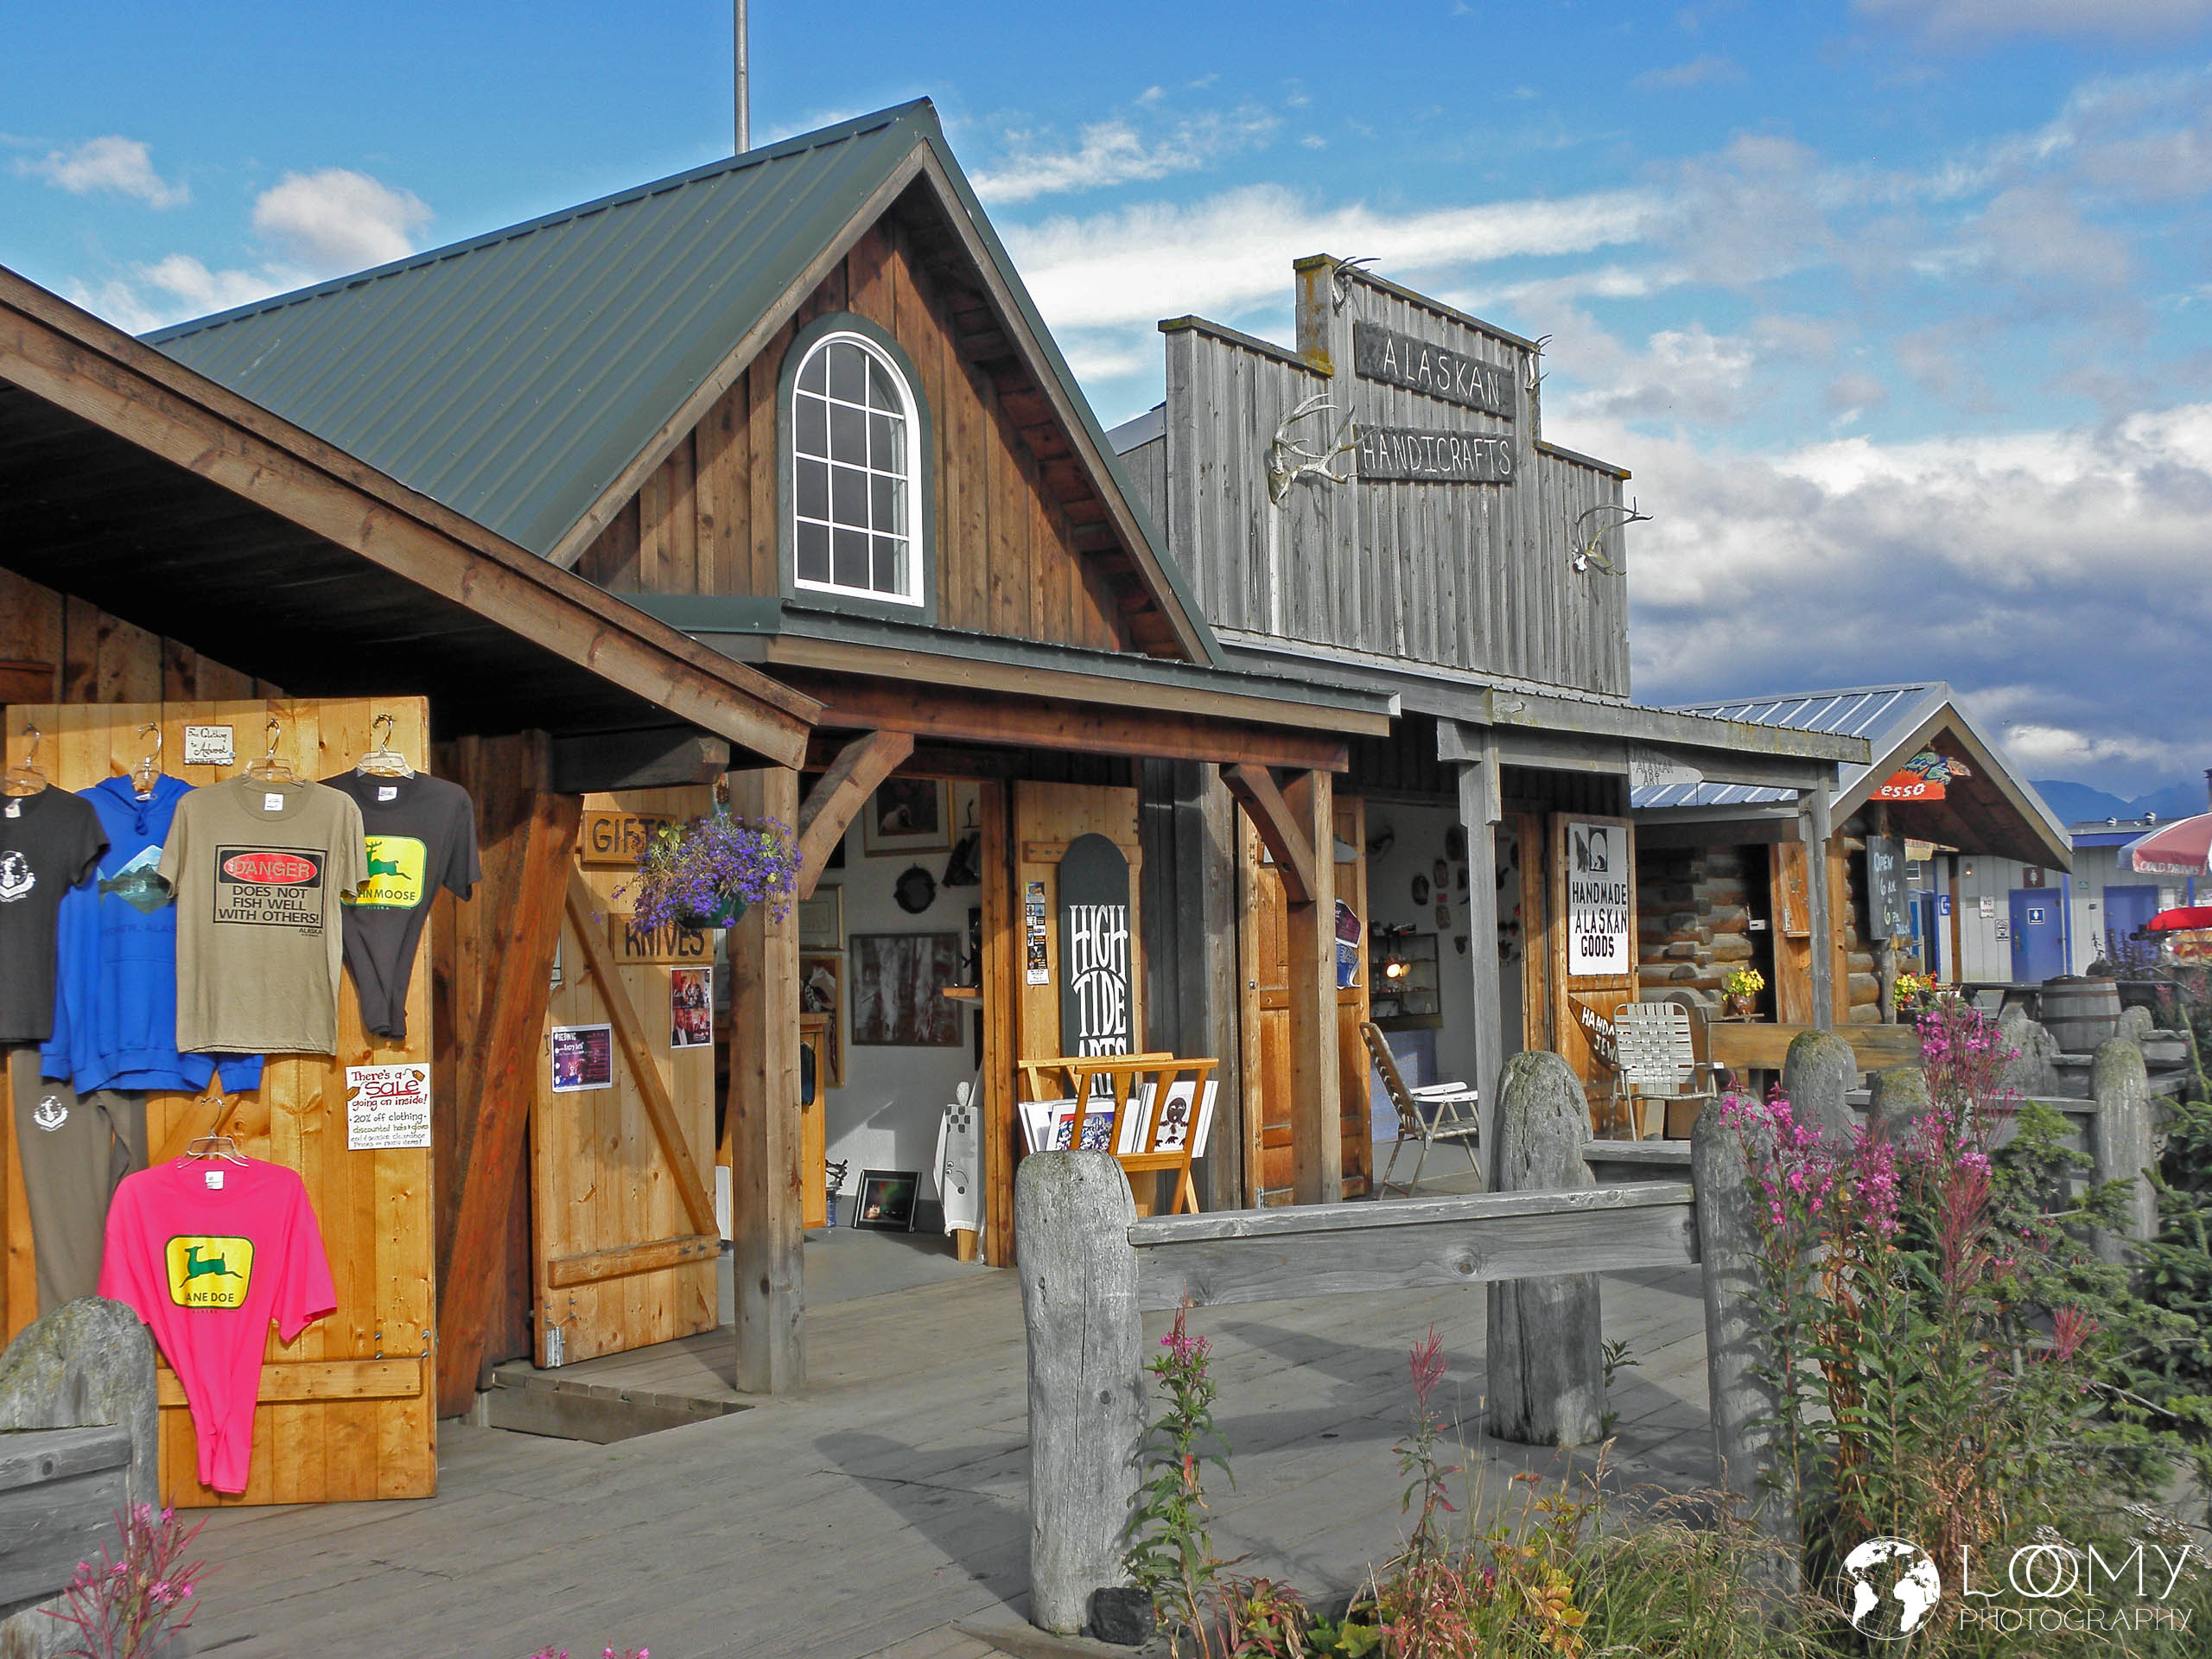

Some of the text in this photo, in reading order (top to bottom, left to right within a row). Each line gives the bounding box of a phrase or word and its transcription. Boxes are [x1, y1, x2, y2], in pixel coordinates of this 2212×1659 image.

[1383, 338, 1500, 410] ALASKAN
[1361, 432, 1510, 481] HANDICRAFTS
[1643, 772, 1660, 786] ART
[1880, 783, 1926, 798] esso
[233, 860, 309, 878] DANGER
[2139, 861, 2164, 873] COLD
[232, 886, 308, 899] DOES NOT
[374, 889, 416, 900] MOOSE
[1573, 881, 1627, 905] HANDMADE
[1880, 878, 1886, 896] 6
[232, 897, 307, 911] FISH WELL
[219, 909, 320, 924] WITH OTHERS!
[1575, 908, 1627, 934] ALASKAN
[1884, 906, 1891, 925] 6
[625, 921, 705, 957] KNIVES
[1069, 905, 1128, 985] HIGH
[1581, 935, 1614, 958] GOODS
[1072, 970, 1127, 1037] TIDE
[352, 1070, 391, 1081] There's
[352, 1098, 378, 1111] going
[395, 1094, 428, 1105] inside!
[353, 1112, 423, 1124] 20% off clothing
[353, 1124, 391, 1134] discounted
[187, 1293, 234, 1302] ANE DOE
